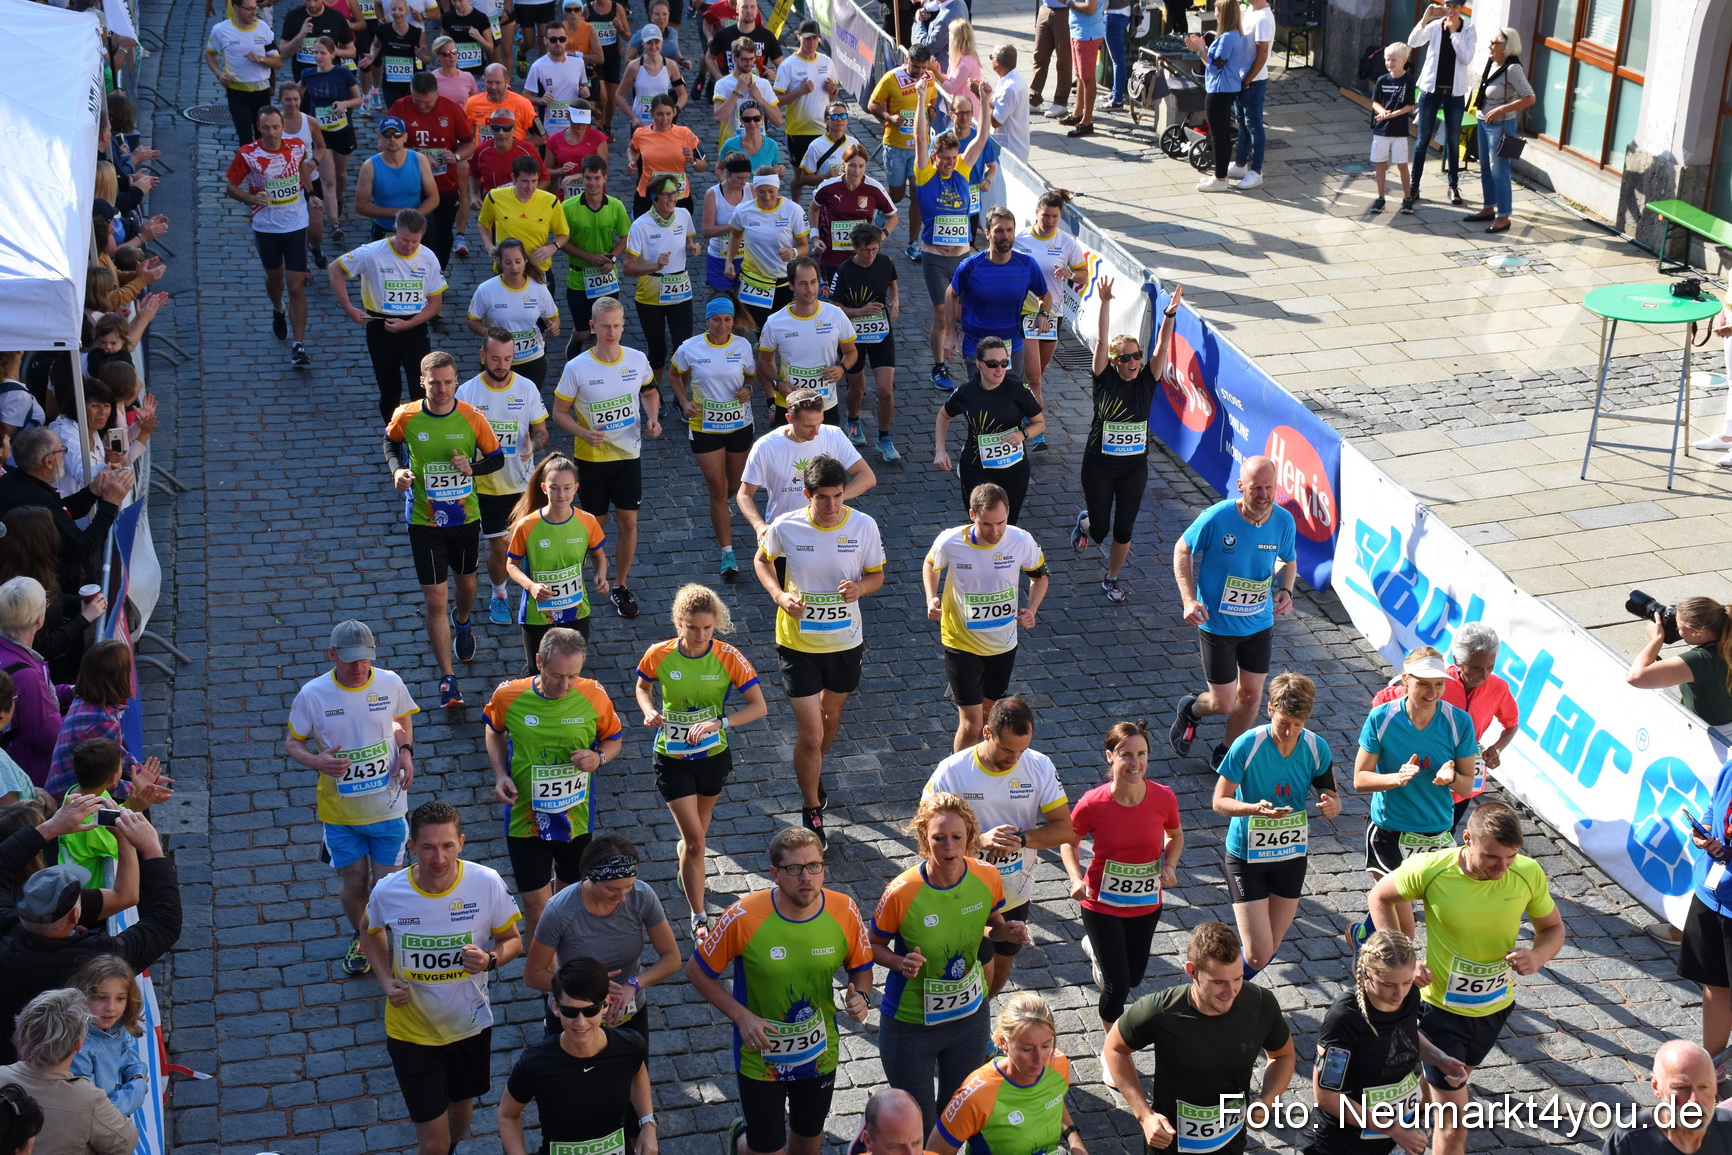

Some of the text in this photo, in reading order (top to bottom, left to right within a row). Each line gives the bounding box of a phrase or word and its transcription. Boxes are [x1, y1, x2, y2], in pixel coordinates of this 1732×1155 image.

[598, 30, 615, 38] 645
[298, 46, 314, 54] 265
[457, 51, 478, 60] 2027
[387, 64, 410, 74] 2028
[551, 109, 569, 118] 233
[416, 130, 429, 146] T
[266, 175, 298, 188] BOCK
[271, 186, 297, 199] 1098
[937, 226, 965, 235] 2490
[384, 281, 423, 290] BOCK
[588, 273, 614, 288] 2040
[594, 285, 613, 294] ANDRE
[665, 282, 690, 293] 2415
[742, 285, 770, 298] 2795
[388, 291, 420, 303] 2173
[852, 311, 886, 322] BOCK
[856, 321, 885, 334] 2592
[515, 338, 537, 350] 172
[515, 349, 534, 359] AMARA
[791, 366, 827, 376] BOCK
[792, 377, 825, 389] 2201
[592, 396, 631, 411] BOCK
[705, 400, 743, 410] BOCK
[1221, 388, 1244, 411] STORE
[596, 406, 631, 424] 2670
[707, 411, 740, 422] 2200
[606, 421, 625, 430] LUKA
[1108, 423, 1144, 432] BOCK
[1228, 413, 1249, 441] ONLINE
[1107, 433, 1141, 445] 2595
[997, 457, 1011, 466] UTE
[430, 474, 467, 489] 2512
[1270, 432, 1331, 527] Hervis
[435, 488, 464, 497] MARTIN
[837, 535, 848, 544] 20
[993, 553, 1004, 561] 20
[537, 568, 580, 583] BOCK
[551, 580, 579, 597] 511
[1227, 577, 1270, 591] BOCK
[551, 597, 573, 607] NORA
[968, 589, 1012, 604] BOCK
[1228, 589, 1267, 605] 2126
[806, 606, 848, 620] 2755
[971, 603, 1012, 620] 2709
[1227, 604, 1261, 613] NORBERT
[668, 708, 712, 723] BOCK
[343, 759, 387, 781] 2432
[352, 780, 383, 791] KLAUS
[539, 777, 582, 798] 2514
[1010, 780, 1020, 789] 20
[540, 794, 580, 809] HELMUTH
[1253, 814, 1303, 829] BOCK
[1255, 830, 1301, 847] 2462
[1258, 846, 1297, 858] MELANIE
[1109, 862, 1158, 877] BOCK
[1108, 877, 1155, 894] 2828
[450, 900, 463, 910] 20
[962, 902, 983, 915] BOCK
[451, 907, 480, 917] Neumarkter
[451, 914, 474, 922] Stadtlauf
[398, 918, 421, 927] BOCK
[703, 901, 747, 957] BOCK
[406, 933, 467, 950] BOCK
[812, 947, 835, 955] BOCK
[410, 952, 465, 970] 1064
[1457, 960, 1509, 979] BOCK
[411, 970, 464, 983] YEVGENIY
[928, 968, 979, 994] BOCK
[1456, 973, 1507, 993] 2675
[932, 983, 979, 1011] 2731
[769, 1029, 821, 1054] 2730
[1371, 1076, 1417, 1102] BOCK
[945, 1076, 987, 1123] BOCK
[559, 1133, 620, 1155] BOCK
